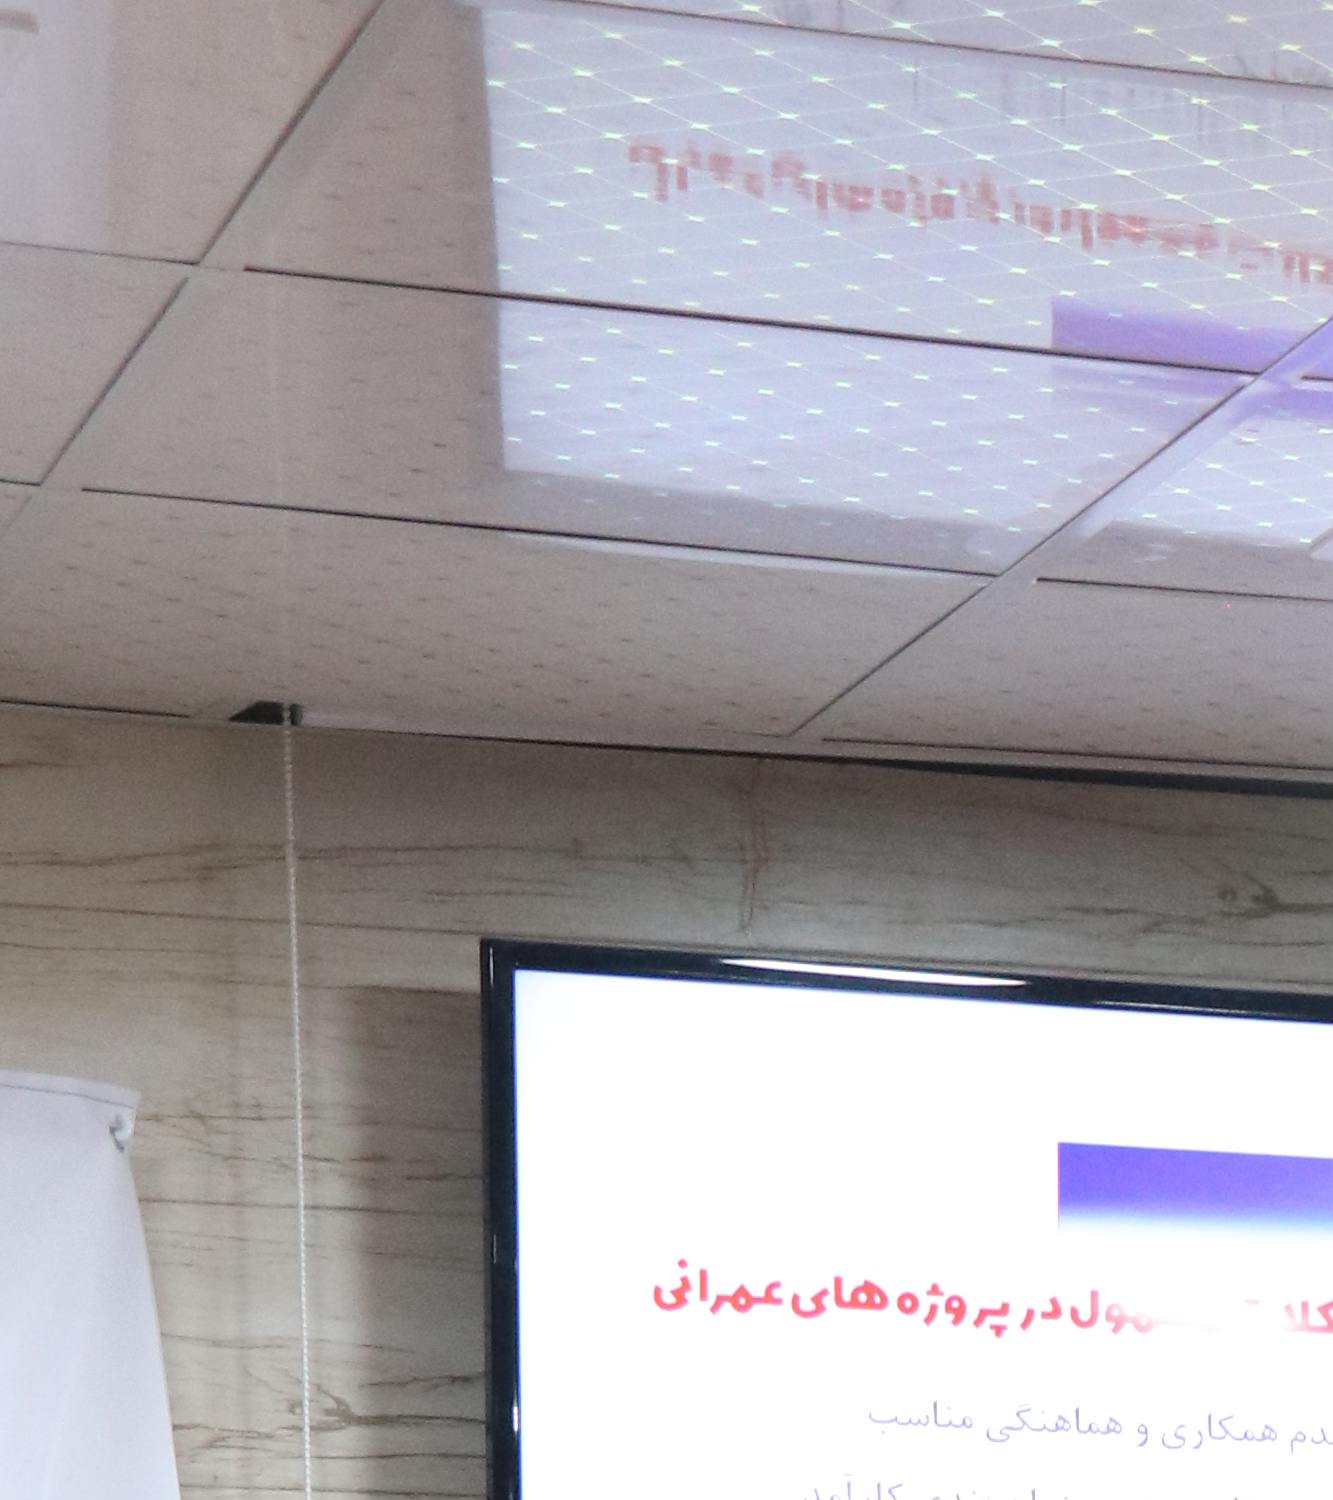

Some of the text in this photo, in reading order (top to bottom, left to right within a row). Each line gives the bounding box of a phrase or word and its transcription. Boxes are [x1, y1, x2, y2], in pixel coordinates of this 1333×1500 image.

[653, 1258, 784, 1316] عمرانی
[791, 1276, 889, 1319] های
[897, 1282, 1011, 1338] پروژه
[1019, 1296, 1063, 1332] در
[868, 1400, 974, 1432] مناسب
[986, 1402, 1124, 1443] هماهنگی
[1161, 1412, 1279, 1450] همکاری
[1136, 1425, 1149, 1447] و
